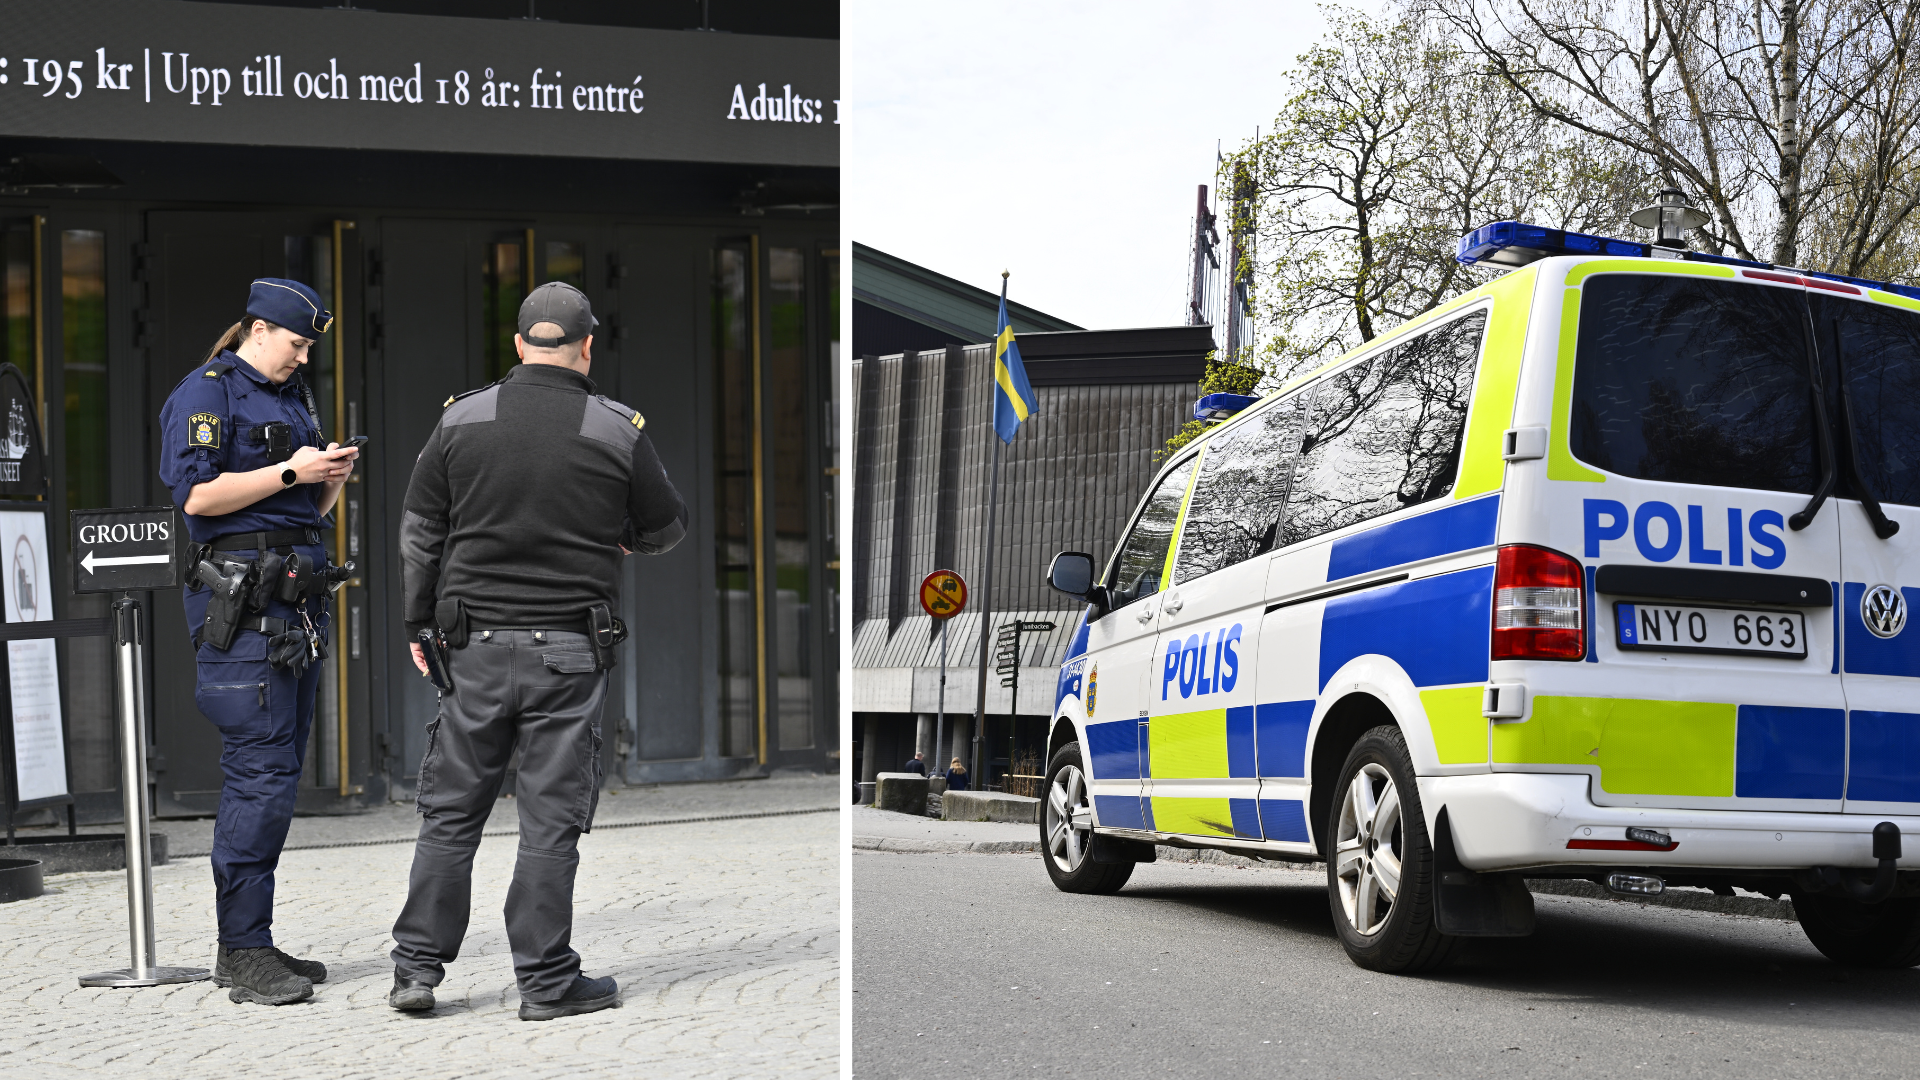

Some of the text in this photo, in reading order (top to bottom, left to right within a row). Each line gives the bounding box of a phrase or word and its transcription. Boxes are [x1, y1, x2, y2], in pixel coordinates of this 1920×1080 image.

[23, 59, 83, 99] 195
[96, 48, 133, 89] kr
[162, 52, 230, 106] Upp
[242, 55, 283, 96] till
[294, 58, 349, 99] och
[359, 63, 423, 103] med
[436, 70, 469, 105] 18
[482, 68, 520, 108] år:
[530, 68, 563, 109] fri
[573, 76, 643, 113] entré
[727, 83, 822, 123] Adults:
[192, 415, 218, 425] POLIS
[80, 522, 169, 544] GROUPS
[1583, 499, 1786, 569] POLIS
[1625, 628, 1632, 638] S
[1640, 609, 1796, 647] NYO 663
[1162, 623, 1242, 700] POLIS
